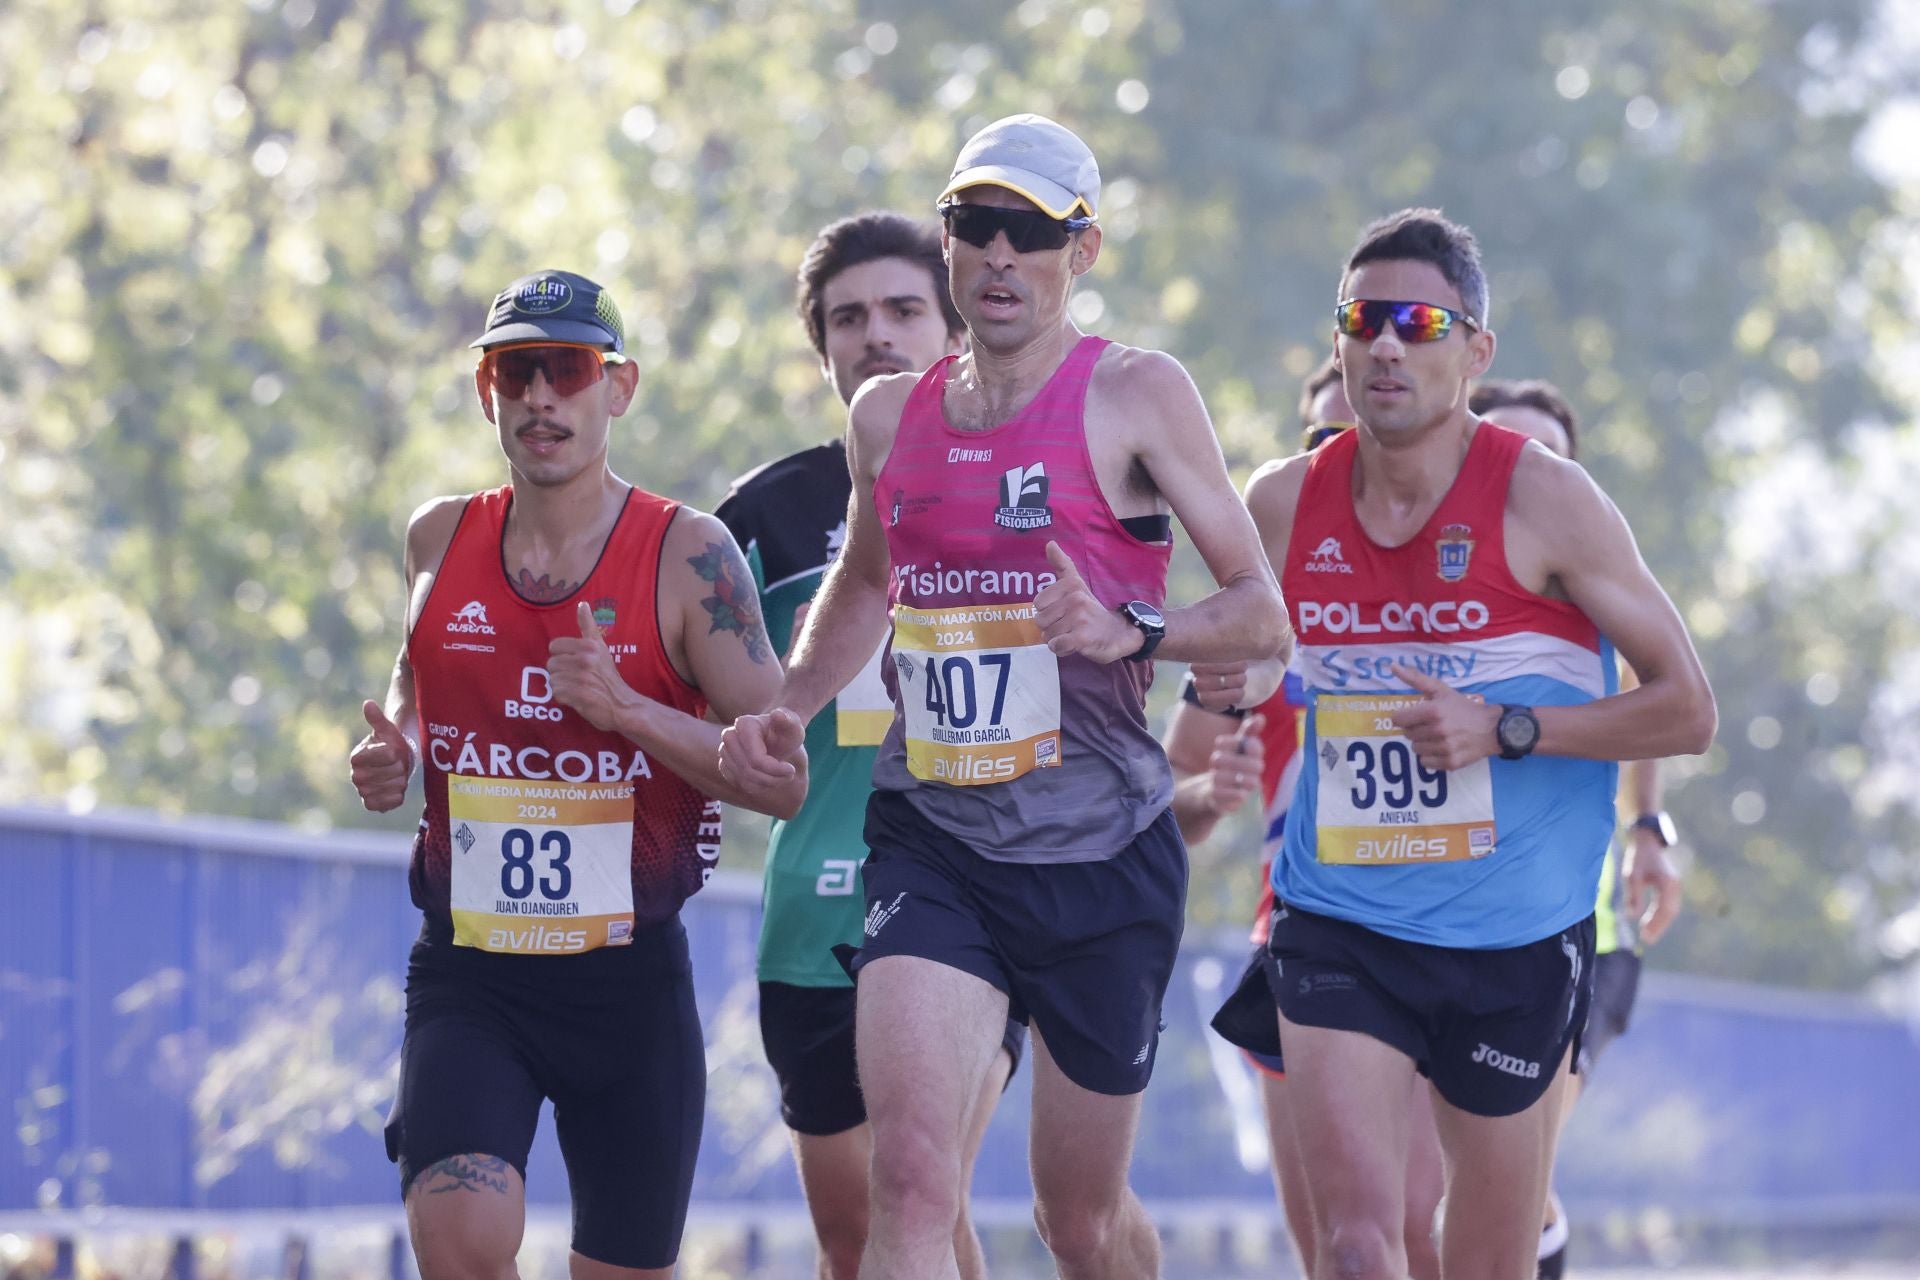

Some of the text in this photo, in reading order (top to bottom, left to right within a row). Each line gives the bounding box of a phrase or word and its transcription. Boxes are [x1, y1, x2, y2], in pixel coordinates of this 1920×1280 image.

[519, 281, 566, 298] TRI4FIT
[995, 513, 1052, 529] FISIORAMA
[939, 608, 1002, 626] MARATÓN
[1298, 600, 1490, 634] POLANCO
[935, 630, 975, 646] 2024
[925, 653, 1012, 729] 407
[505, 699, 564, 722] Beco
[428, 722, 459, 738] GRUPO
[932, 725, 1012, 744] GUILLERMO GARCÍA
[430, 731, 653, 783] CÁRCOBA
[934, 754, 1017, 780] avilés
[1346, 741, 1448, 810] 399
[484, 786, 522, 798] MEDIA
[524, 785, 588, 801] MARATÓN
[517, 804, 557, 819] 2024
[1378, 811, 1419, 825] ANIEVAS
[1355, 832, 1449, 859] avilés
[500, 827, 572, 901] 83
[495, 900, 579, 916] JUAN OJANGUREN
[487, 925, 588, 951] avilés
[1471, 1042, 1541, 1079] Joma
